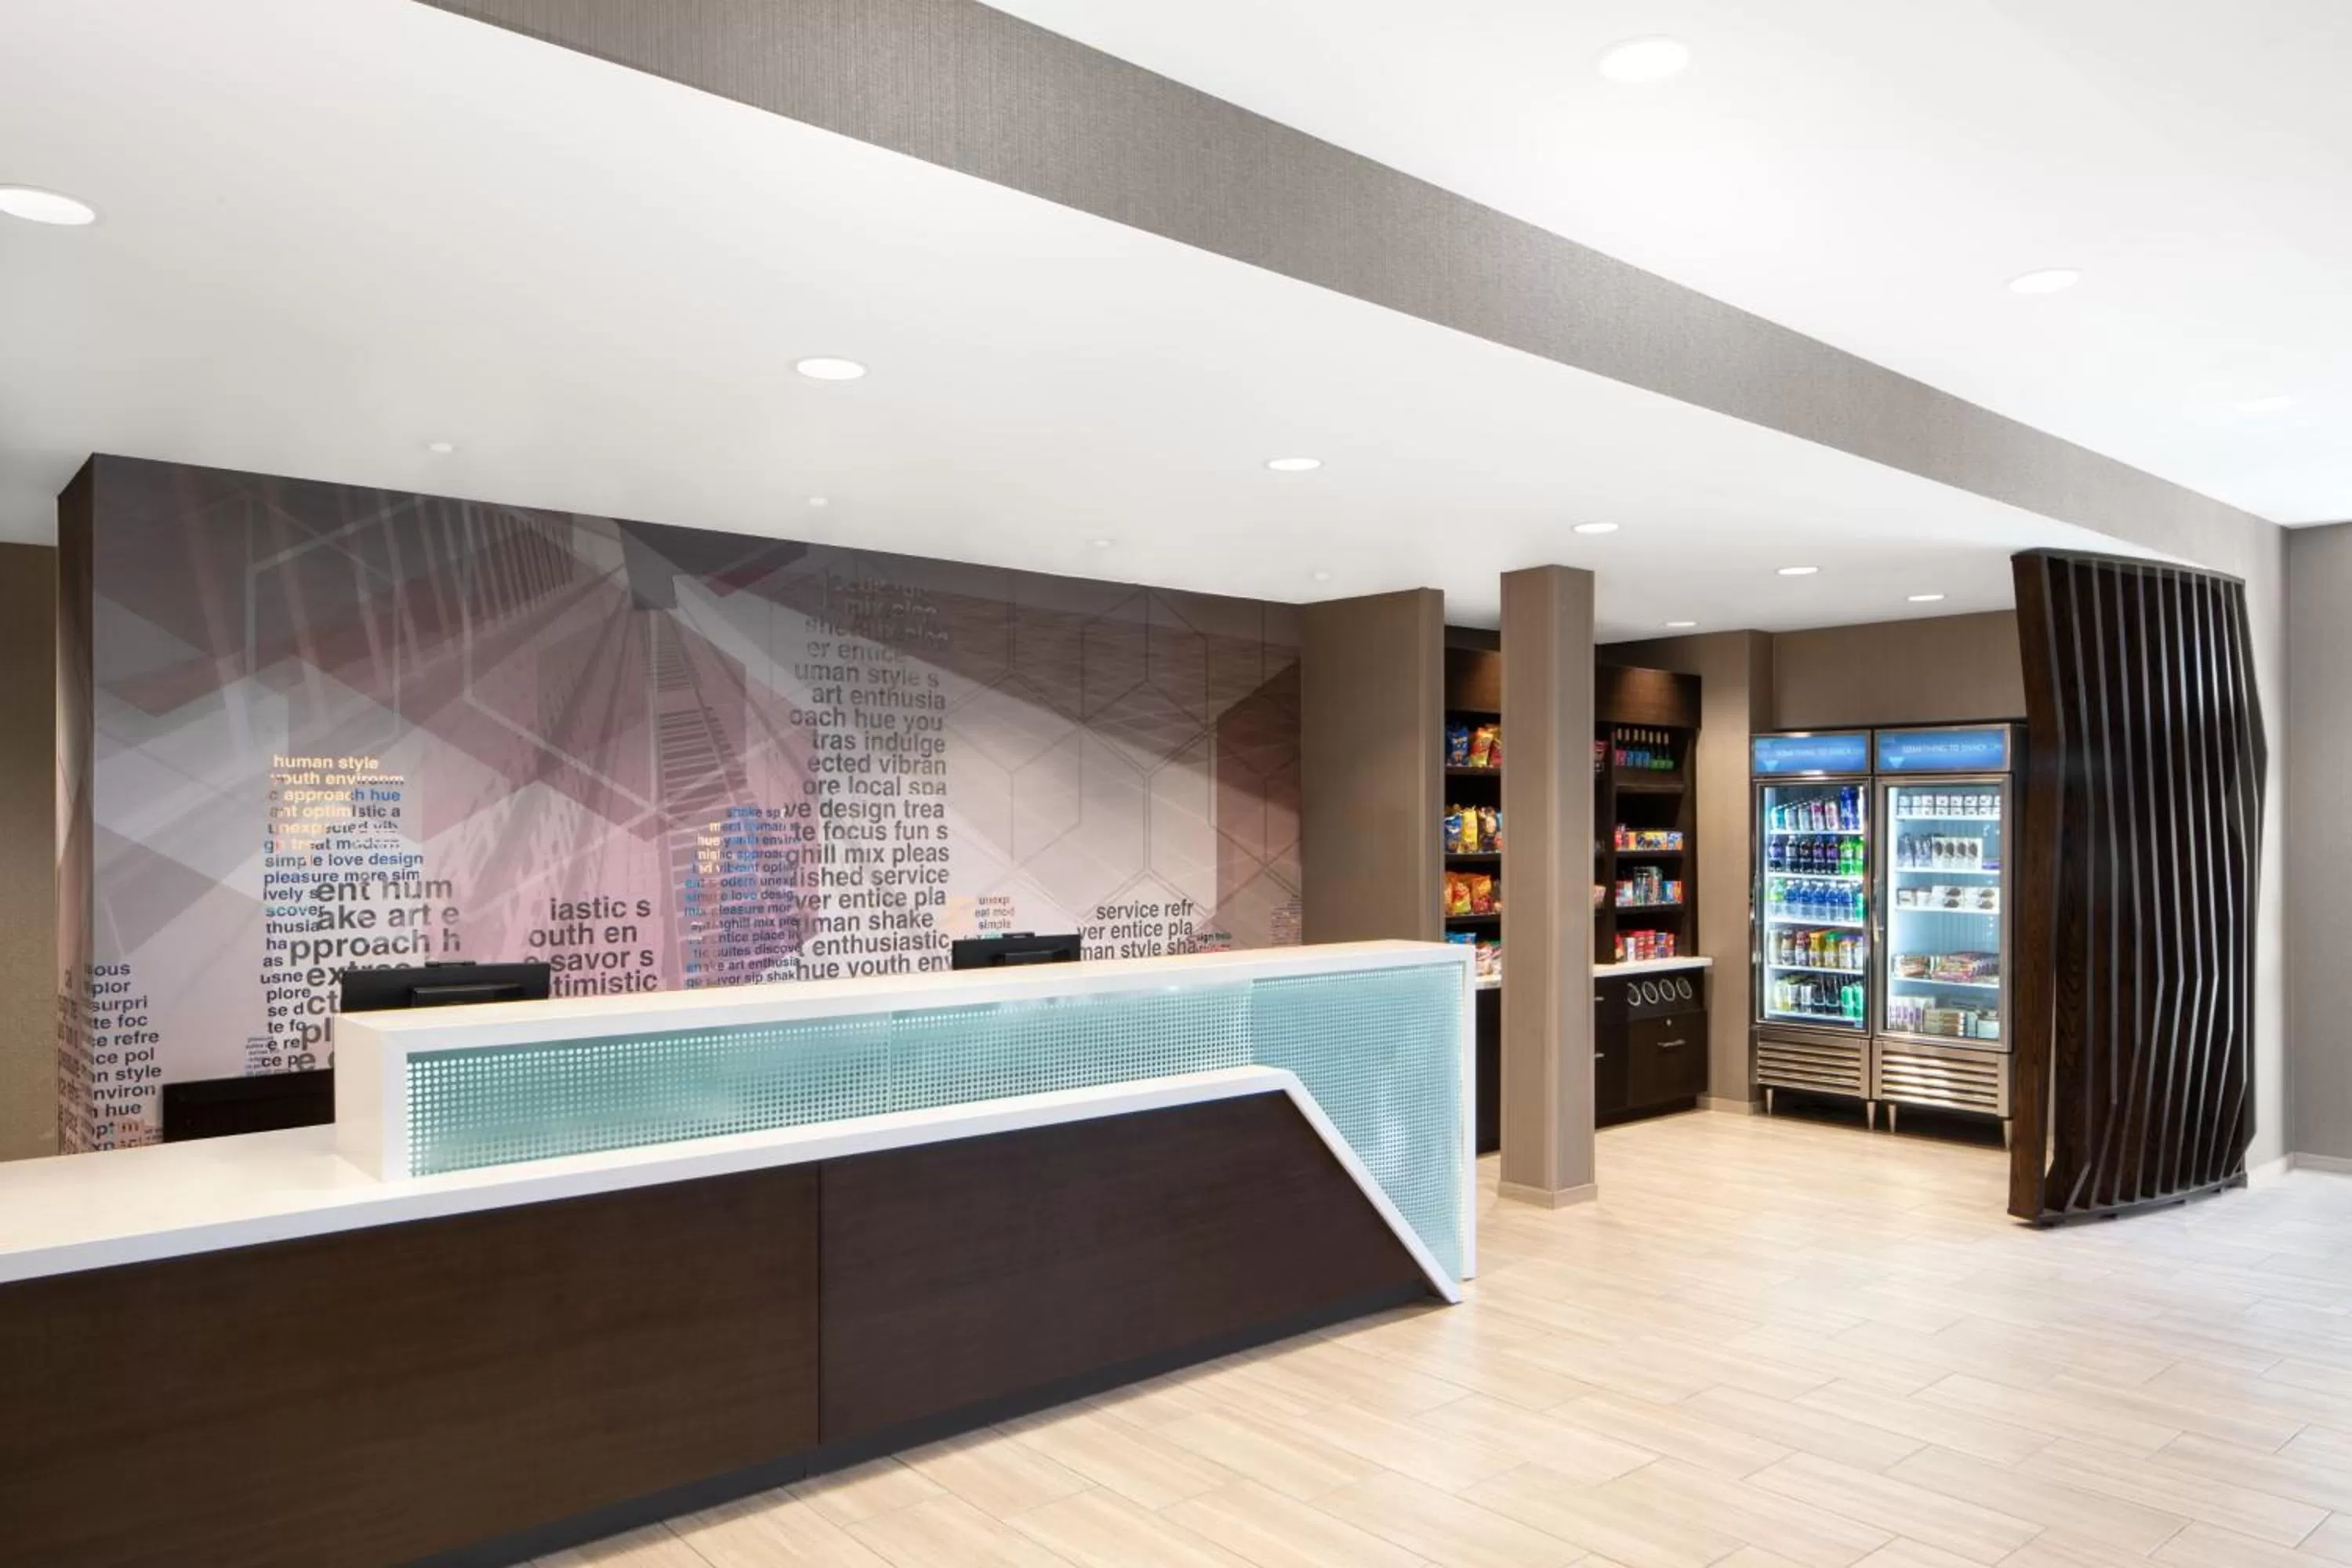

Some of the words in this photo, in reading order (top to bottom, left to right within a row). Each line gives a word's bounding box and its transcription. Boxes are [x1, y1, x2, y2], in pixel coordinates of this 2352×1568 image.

[794, 662, 860, 682] uman
[868, 666, 925, 688] style
[811, 684, 843, 706] art
[850, 687, 946, 710] enthusia
[789, 706, 846, 727] oach
[854, 708, 895, 729] hue
[903, 713, 943, 735] you
[812, 729, 856, 750] tras
[865, 731, 946, 757] indulge
[274, 755, 333, 769] human
[338, 756, 379, 771] style
[808, 753, 871, 773] ected
[879, 753, 946, 775] vibran
[802, 779, 840, 795] ore
[848, 775, 901, 796] local
[284, 789, 365, 804] approach
[370, 789, 401, 801] hue
[303, 804, 387, 820] optimistic
[819, 798, 895, 823] design
[904, 800, 946, 818] trea
[823, 820, 887, 841] focus
[895, 820, 929, 840] fun
[936, 823, 949, 840] s
[328, 852, 363, 866] love
[368, 852, 424, 868] design
[844, 844, 885, 863] mix
[891, 843, 950, 867] pleas
[264, 871, 339, 887] pleasure
[344, 870, 388, 883] more
[391, 869, 420, 881] sim
[871, 864, 949, 885] service
[317, 879, 371, 902] ent
[381, 877, 453, 900] hum
[796, 893, 832, 911] ver
[839, 888, 908, 909] entice
[914, 887, 946, 910] pla
[265, 904, 325, 918] scover
[318, 904, 377, 931] ake
[388, 903, 431, 927] art
[441, 906, 459, 925] e
[550, 896, 626, 920] iastic
[636, 899, 652, 919] s
[1096, 899, 1160, 920] service
[1164, 898, 1194, 917] refr
[267, 920, 320, 934] thusia
[868, 910, 934, 931] shake
[1076, 924, 1105, 941] ver
[1110, 920, 1164, 939] entice
[1168, 918, 1193, 941] pla
[266, 937, 288, 950] ha
[528, 922, 594, 948] outh
[604, 924, 638, 944] en
[812, 930, 951, 957] enthusiastic
[290, 929, 430, 967] pproach
[442, 927, 461, 953] h
[1120, 938, 1162, 959] style
[1167, 935, 1196, 956] sha
[263, 956, 284, 968] as
[550, 949, 631, 974] savor
[639, 948, 655, 967] s
[797, 959, 840, 981] hue
[847, 953, 911, 978] youth
[551, 970, 658, 998] timistic
[92, 995, 148, 1013] surpri
[267, 986, 311, 1004] plore
[118, 1014, 148, 1028] foc
[267, 1007, 288, 1018] se
[267, 1021, 285, 1034] te
[301, 1017, 332, 1051] pl
[114, 1031, 160, 1046] refre
[125, 1047, 155, 1066] pol
[115, 1065, 162, 1083] style
[93, 1083, 156, 1101] nviron
[106, 1103, 142, 1117] hue
